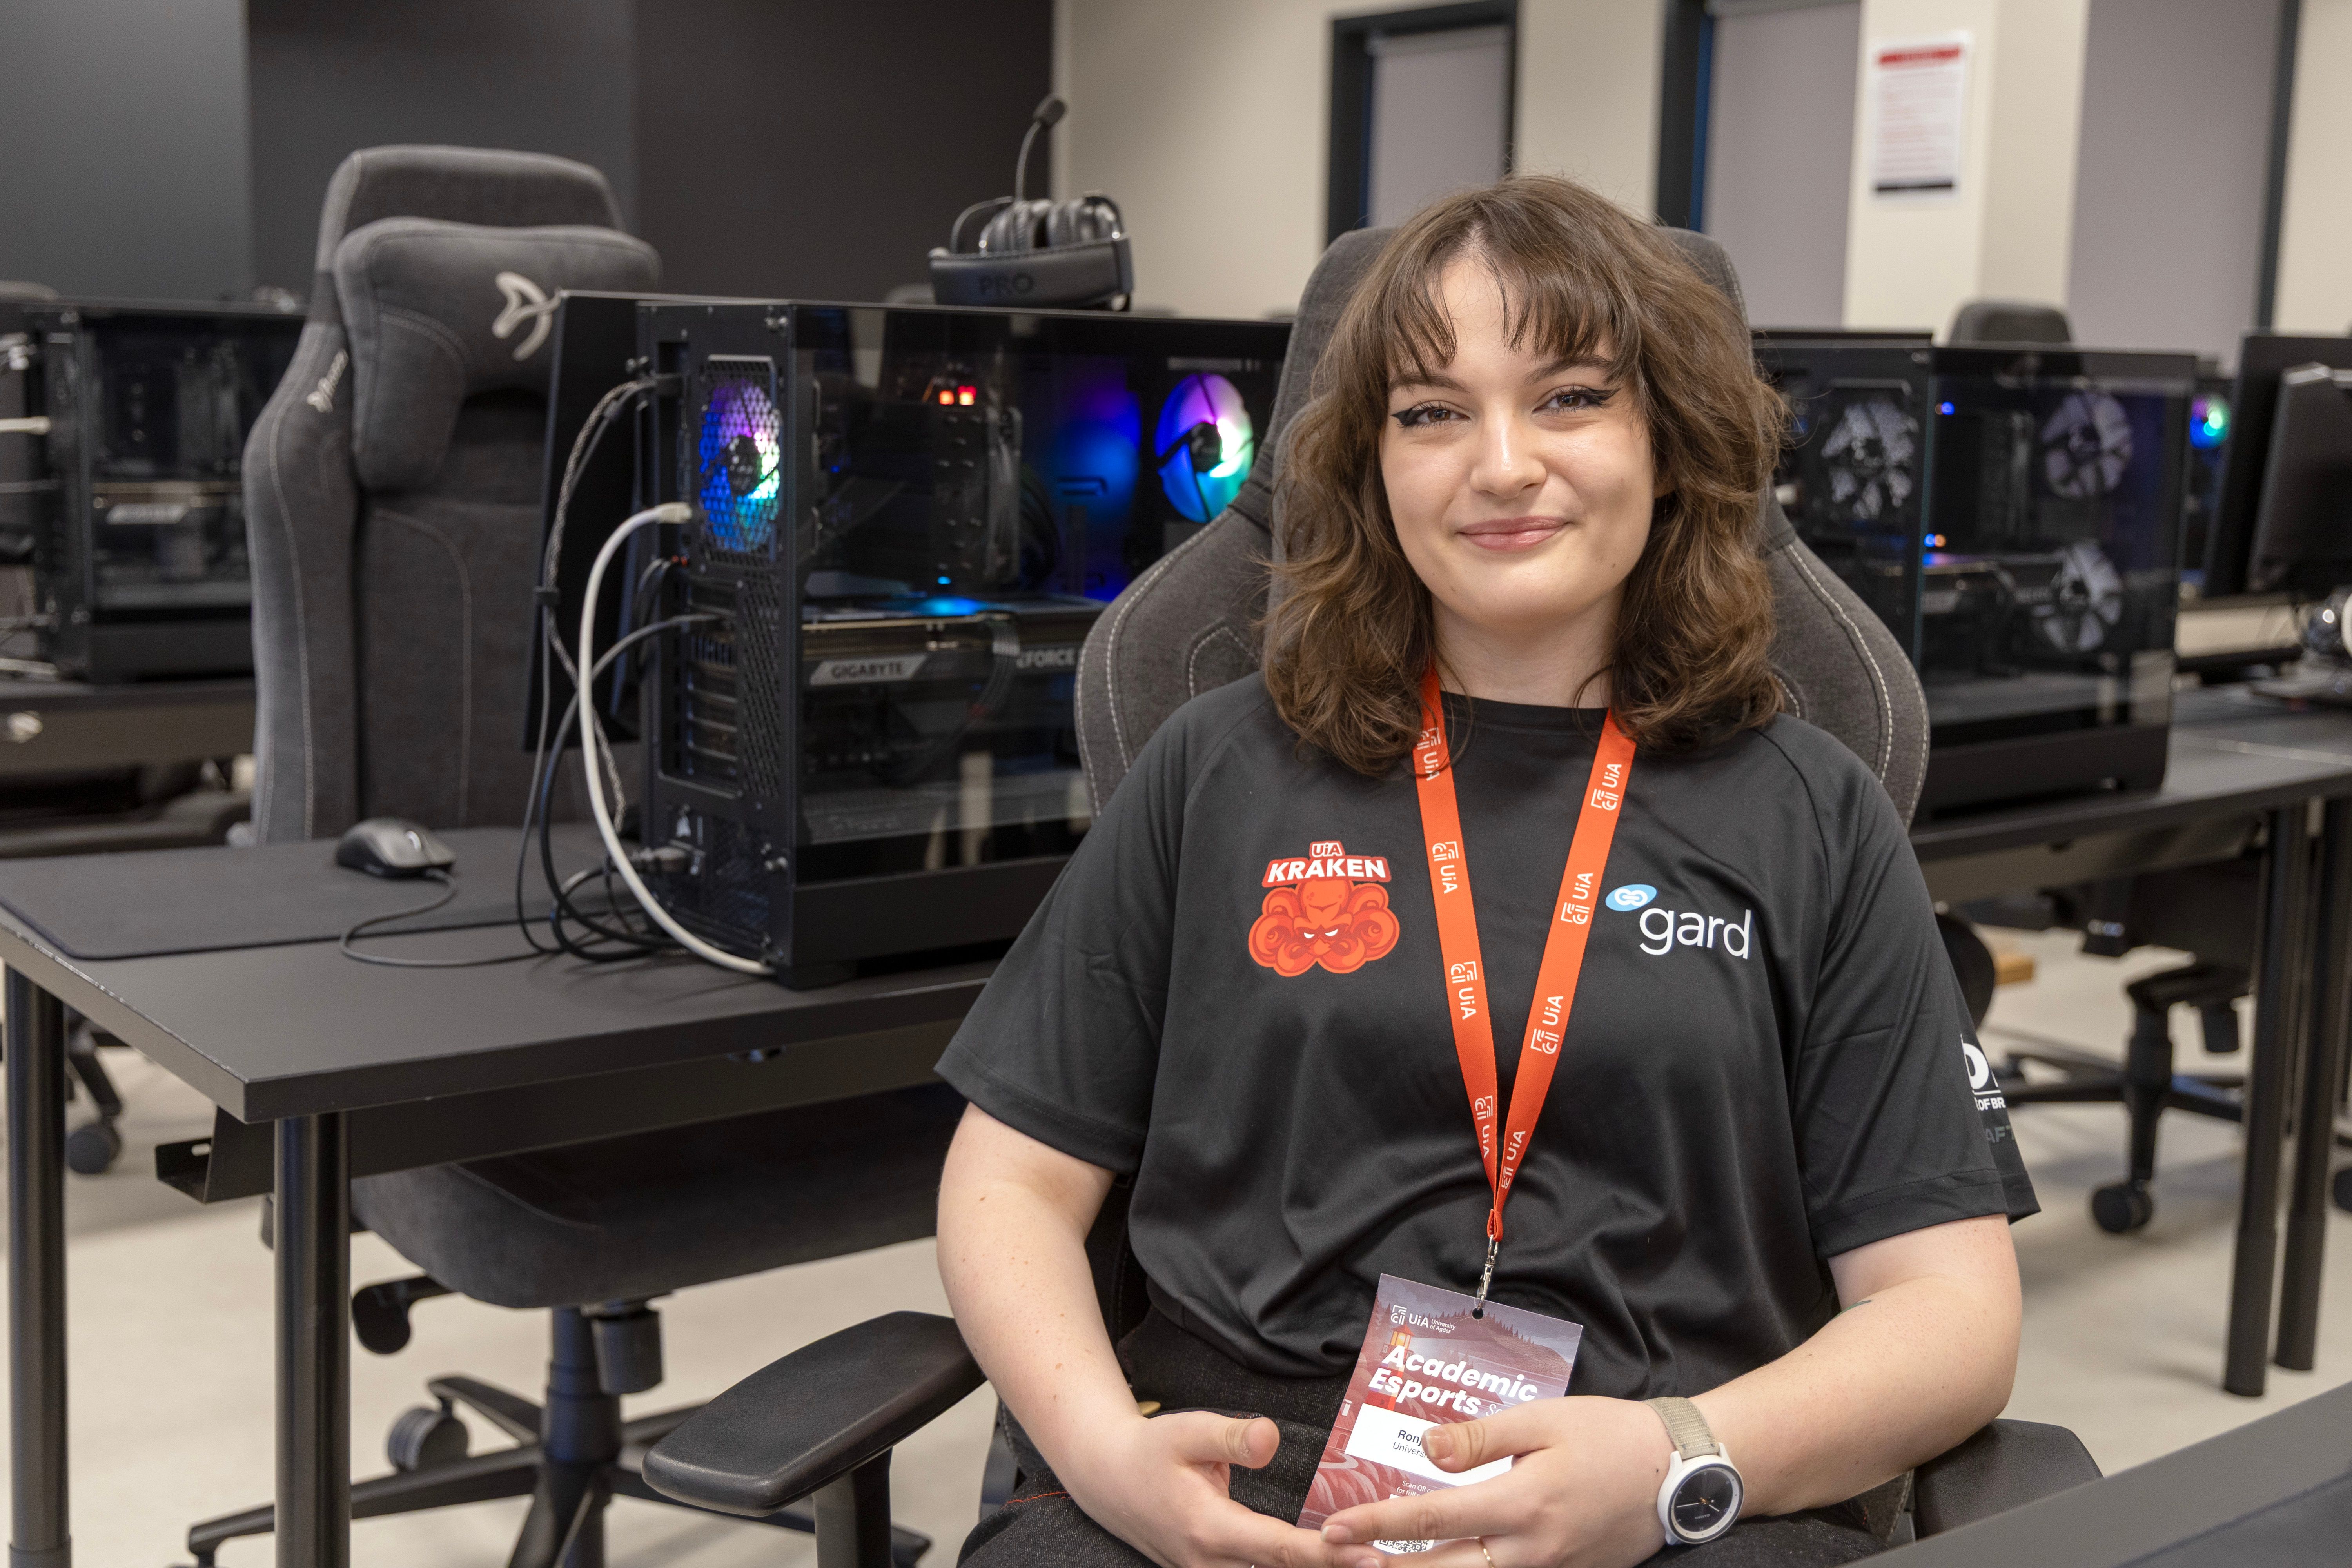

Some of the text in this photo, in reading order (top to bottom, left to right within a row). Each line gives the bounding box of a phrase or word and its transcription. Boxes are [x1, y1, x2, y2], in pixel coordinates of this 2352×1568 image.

[979, 272, 1034, 295] PRO
[831, 662, 903, 679] GIGABYTE
[1423, 751, 1440, 781] UiA
[1602, 764, 1622, 788] UiA
[1312, 843, 1343, 857] UiA
[1267, 858, 1386, 883] KRAKEN
[1440, 864, 1458, 894] UiA
[1572, 873, 1593, 900] UiA
[1639, 908, 1751, 959] gard
[1458, 987, 1477, 1020] UiA
[1542, 995, 1564, 1026] UiA
[1990, 1097, 2006, 1109] BR
[1482, 1124, 1490, 1159] UiA
[1506, 1130, 1526, 1161] UiA
[1408, 1313, 1456, 1330] UiA University
[1381, 1345, 1538, 1401] Academic
[1368, 1367, 1481, 1415] Esports
[1402, 1480, 1416, 1489] Scan
